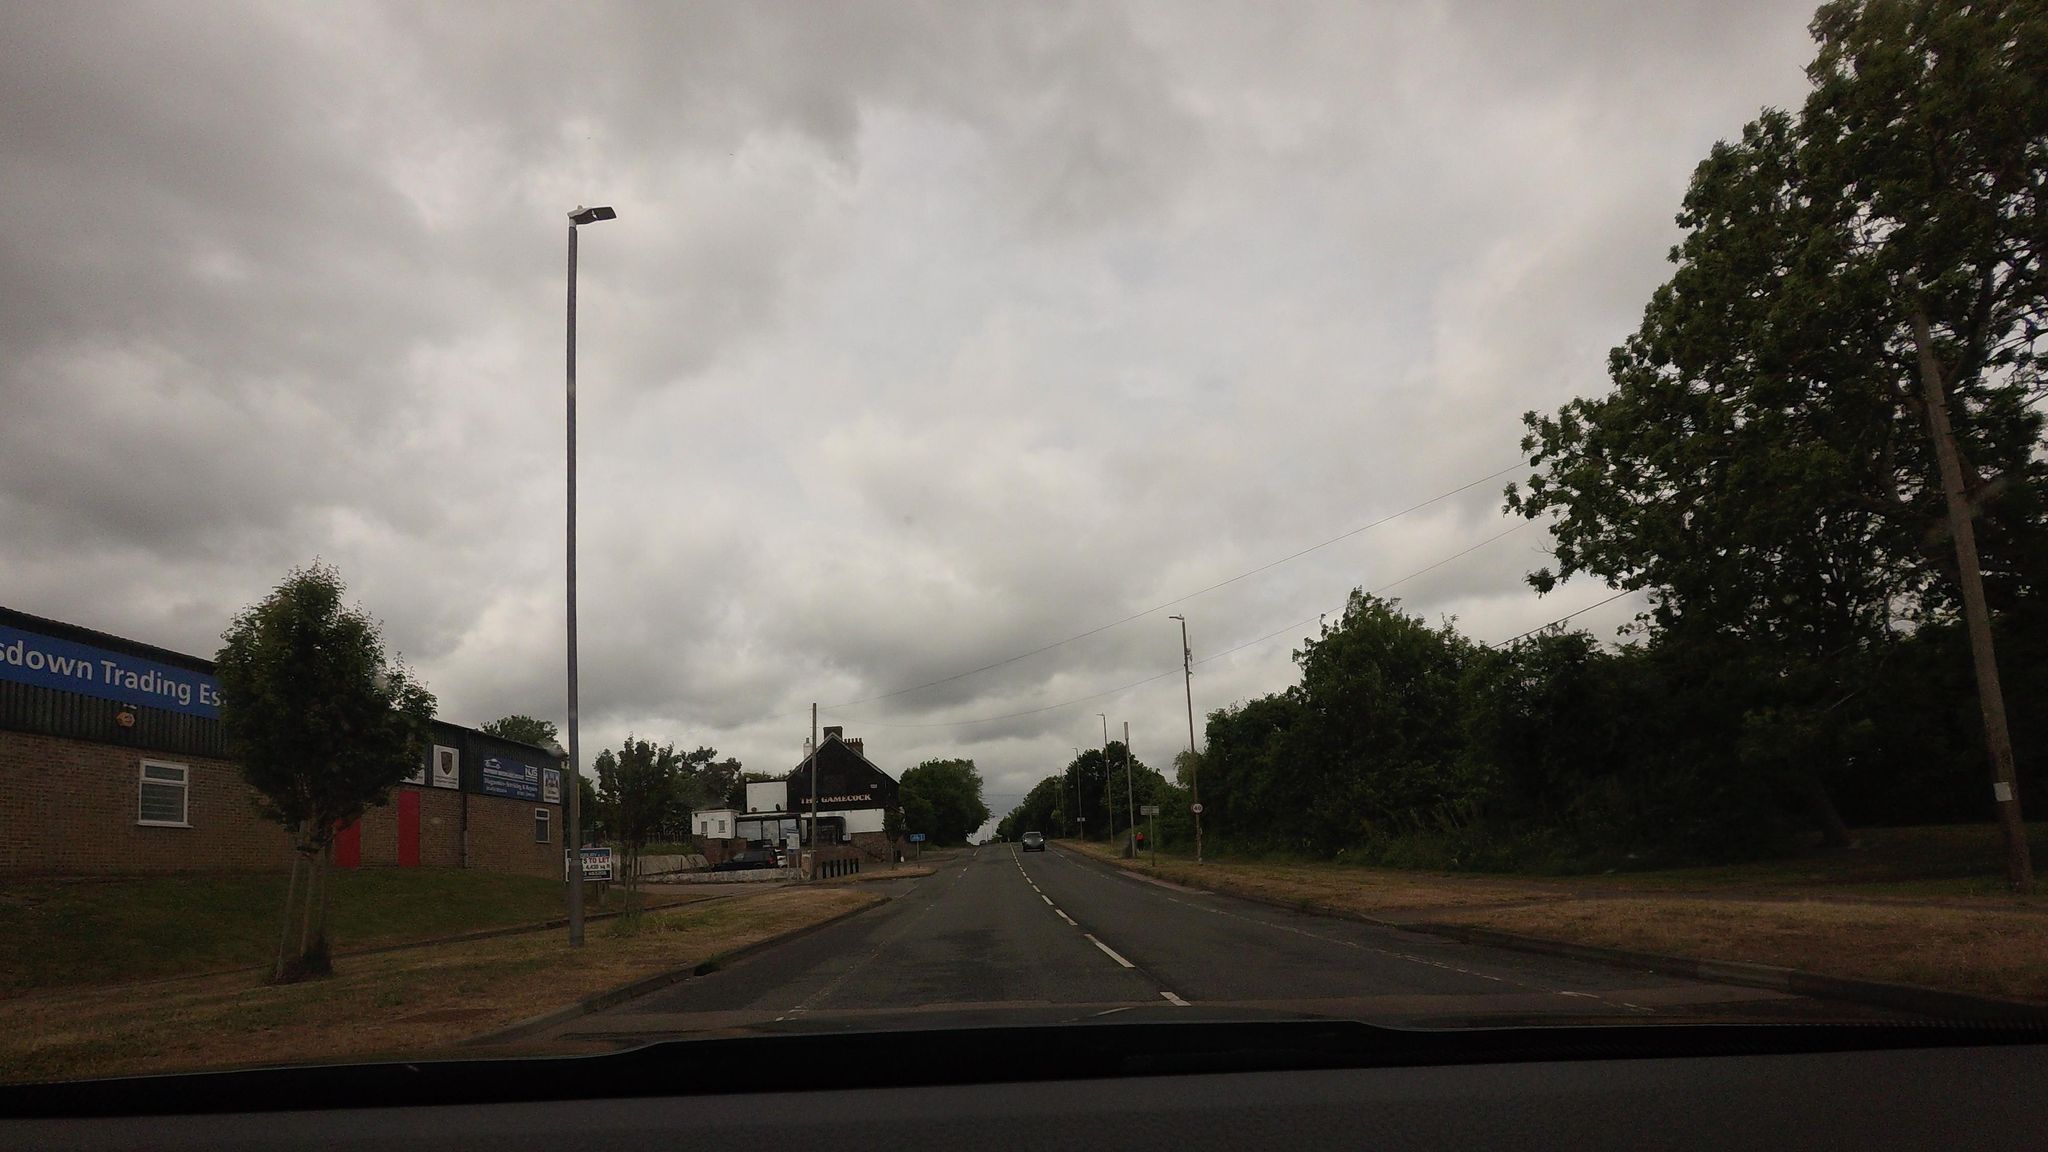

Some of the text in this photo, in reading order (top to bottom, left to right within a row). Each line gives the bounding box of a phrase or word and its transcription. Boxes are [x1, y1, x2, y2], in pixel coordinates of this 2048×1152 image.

[101, 660, 191, 706] Trading
[199, 683, 227, 707] Es
[821, 794, 872, 803] GAMECOCK
[598, 856, 610, 864] LET
